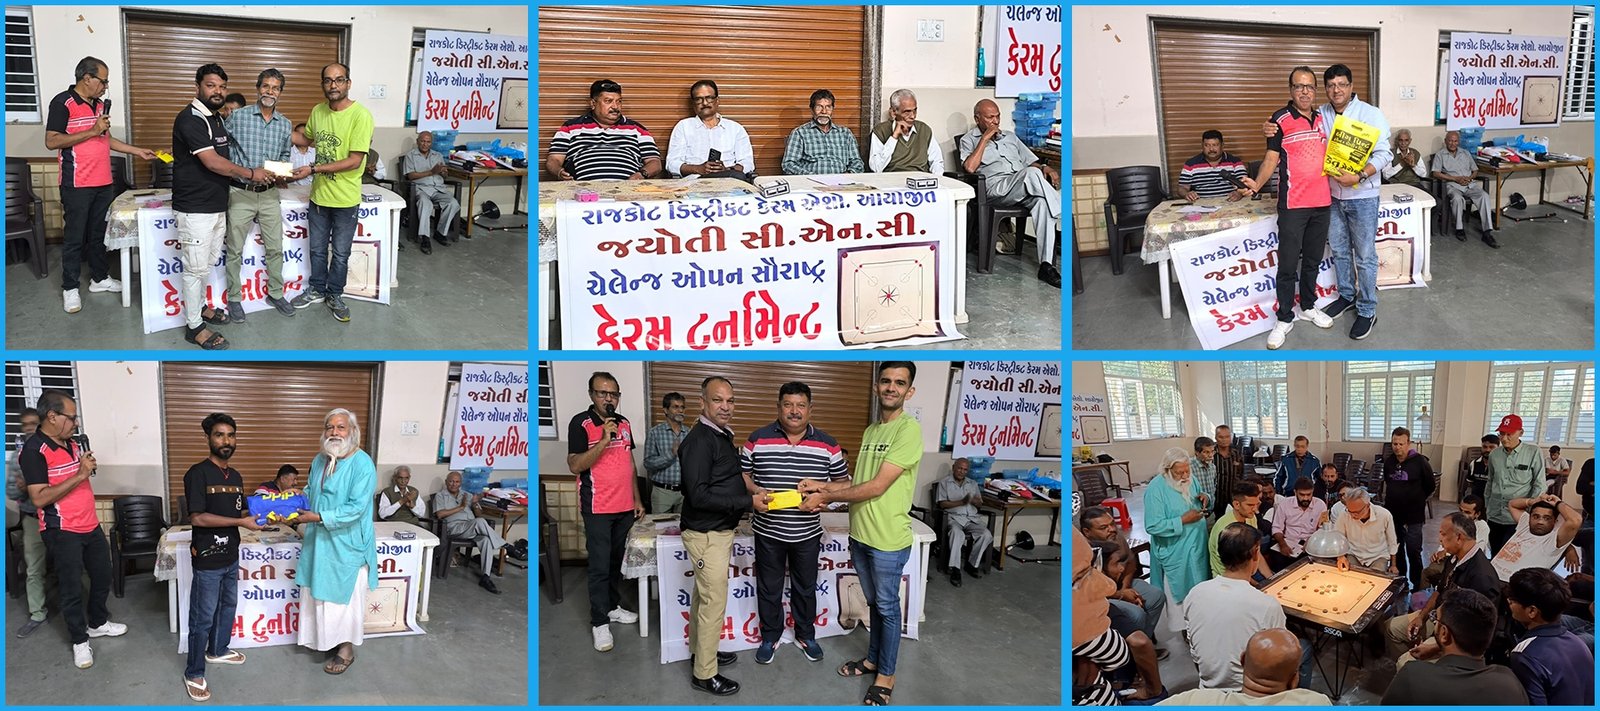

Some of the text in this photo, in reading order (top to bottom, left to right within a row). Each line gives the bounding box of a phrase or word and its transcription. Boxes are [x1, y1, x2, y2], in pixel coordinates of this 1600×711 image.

[429, 37, 455, 48] રાજકોટ
[485, 40, 498, 51] કેરમ
[1008, 27, 1044, 76] કેરમ
[426, 71, 449, 86] ચેલેન્જ
[451, 72, 473, 86] ઓપન
[1477, 72, 1497, 86] ઓપન
[425, 89, 449, 120] કેરમ
[1453, 89, 1476, 118] કેરમ
[582, 202, 661, 225] રાજકોટ
[597, 226, 727, 258] જયોતી
[1190, 246, 1240, 266] રાજકોટ
[586, 257, 826, 296] ચેલેન્જ ઓપન સૌરાષ્ટ્ર
[1202, 286, 1249, 305] ચેલેન્જ
[1209, 304, 1268, 332] કેરમ
[466, 370, 492, 383] રાજકોટ
[964, 395, 988, 410] ચેલેન્જ
[990, 396, 1013, 411] ઓપન
[461, 407, 486, 421] ચેલેન્જ
[488, 407, 511, 422] ઓપન
[961, 413, 987, 446] કેરમ
[459, 425, 484, 456] કેરમ
[243, 585, 286, 600] ઓપન
